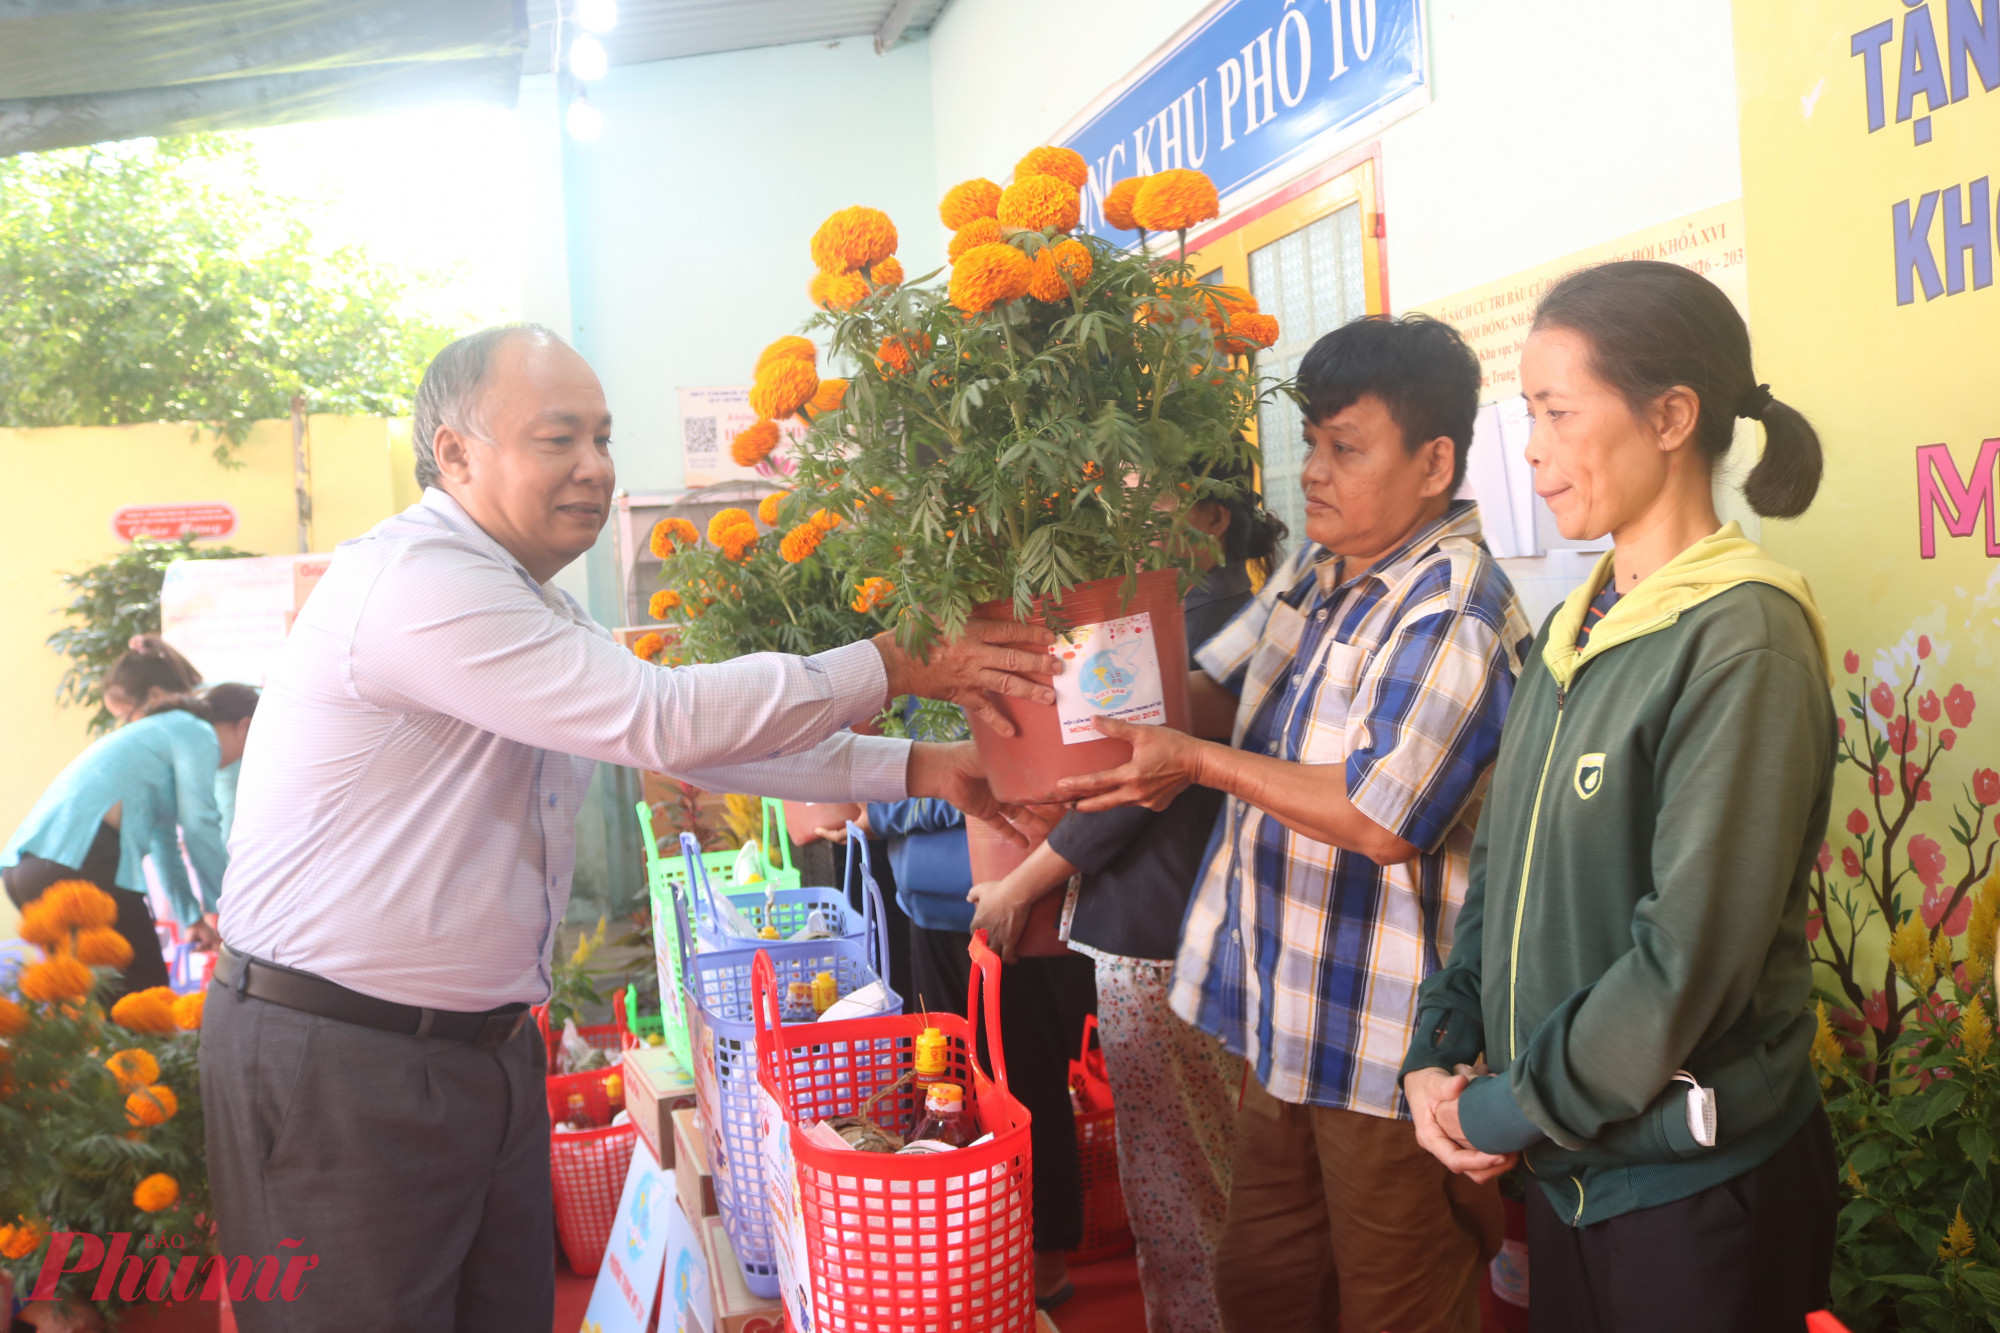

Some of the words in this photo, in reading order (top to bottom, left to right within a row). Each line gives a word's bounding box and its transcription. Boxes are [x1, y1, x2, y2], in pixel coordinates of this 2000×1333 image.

[1132, 77, 1208, 178] KHU
[1324, 0, 1377, 82] 10
[1490, 294, 1505, 311] TRI
[1701, 223, 1725, 244] XVI
[1891, 174, 2000, 308] KH
